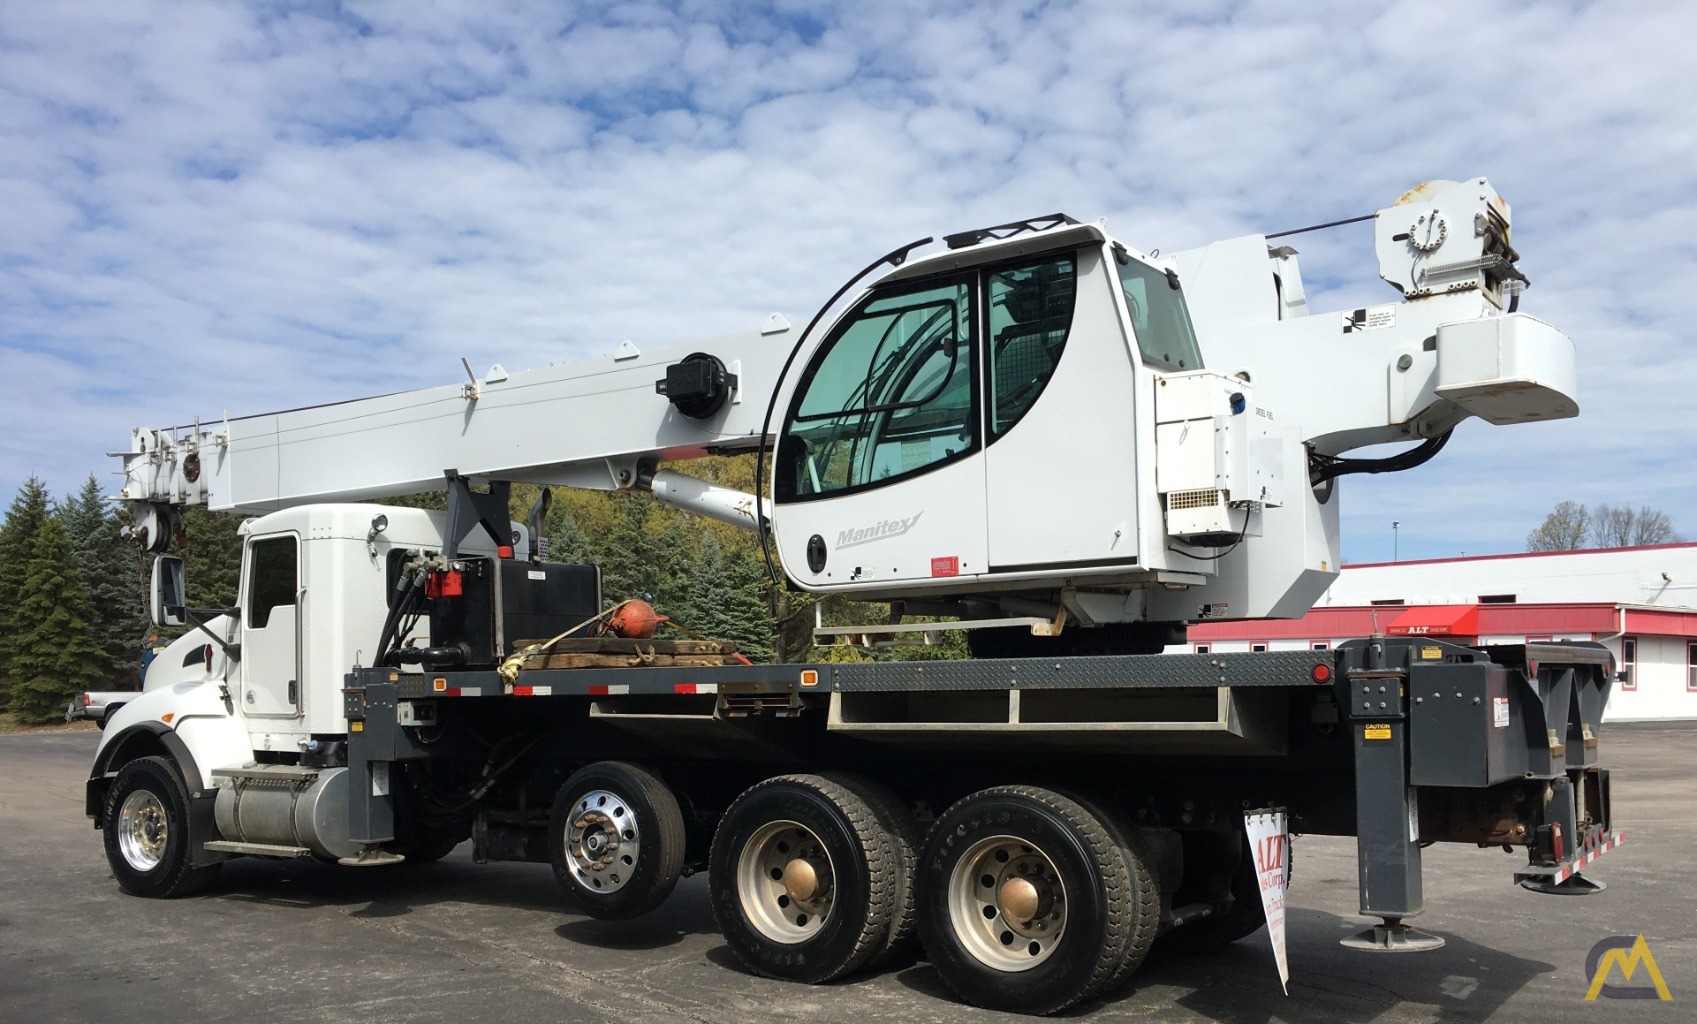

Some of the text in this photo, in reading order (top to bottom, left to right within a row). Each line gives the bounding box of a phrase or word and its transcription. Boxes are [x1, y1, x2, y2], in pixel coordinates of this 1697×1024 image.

[836, 517, 912, 546] Manitex
[1408, 626, 1429, 634] ALT
[931, 811, 1043, 871] Firestoe
[1257, 833, 1287, 875] ALT
